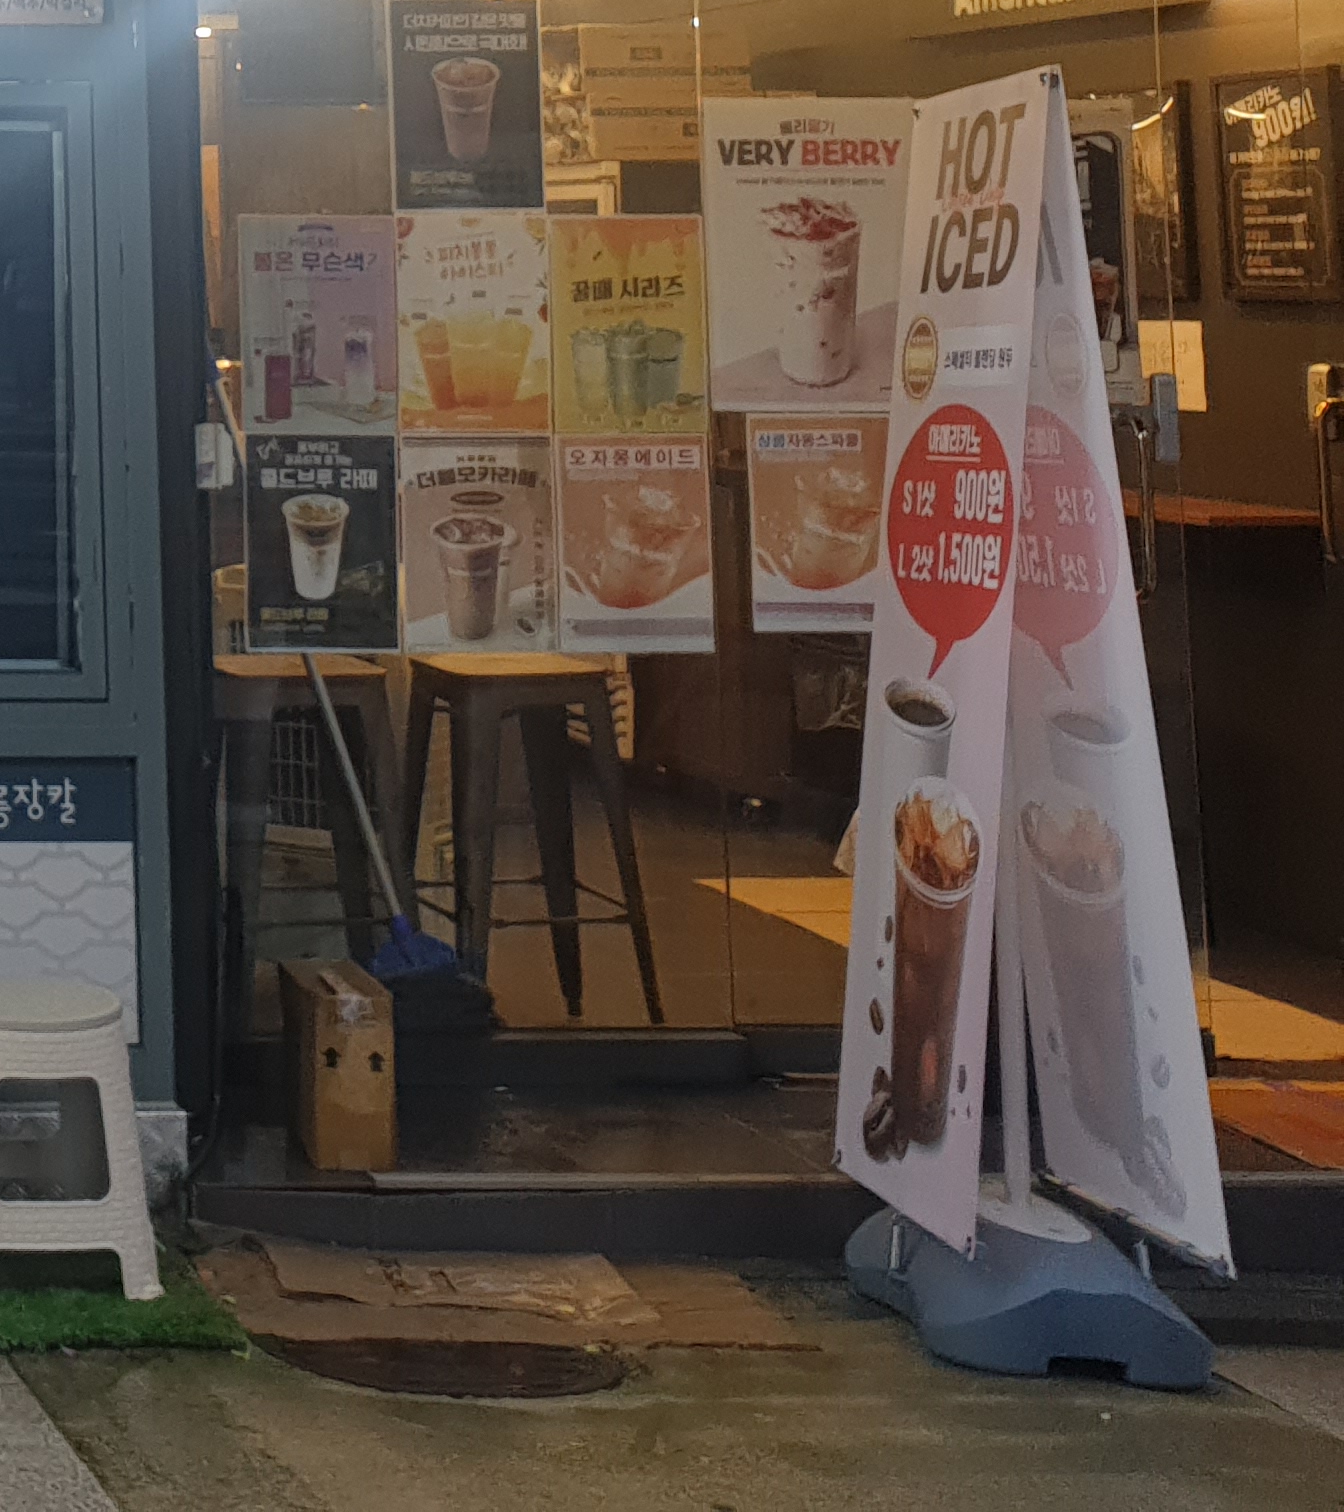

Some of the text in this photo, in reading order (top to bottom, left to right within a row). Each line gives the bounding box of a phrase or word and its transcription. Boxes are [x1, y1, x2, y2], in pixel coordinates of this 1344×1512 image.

[717, 138, 903, 168] VERY BERRY
[935, 101, 1028, 202] HOT
[919, 201, 1020, 295] ICED
[619, 274, 686, 300] 시리즈
[902, 479, 913, 515] S
[953, 468, 1007, 524] 900원
[896, 542, 906, 578] L
[937, 530, 1003, 590] 1,500원
